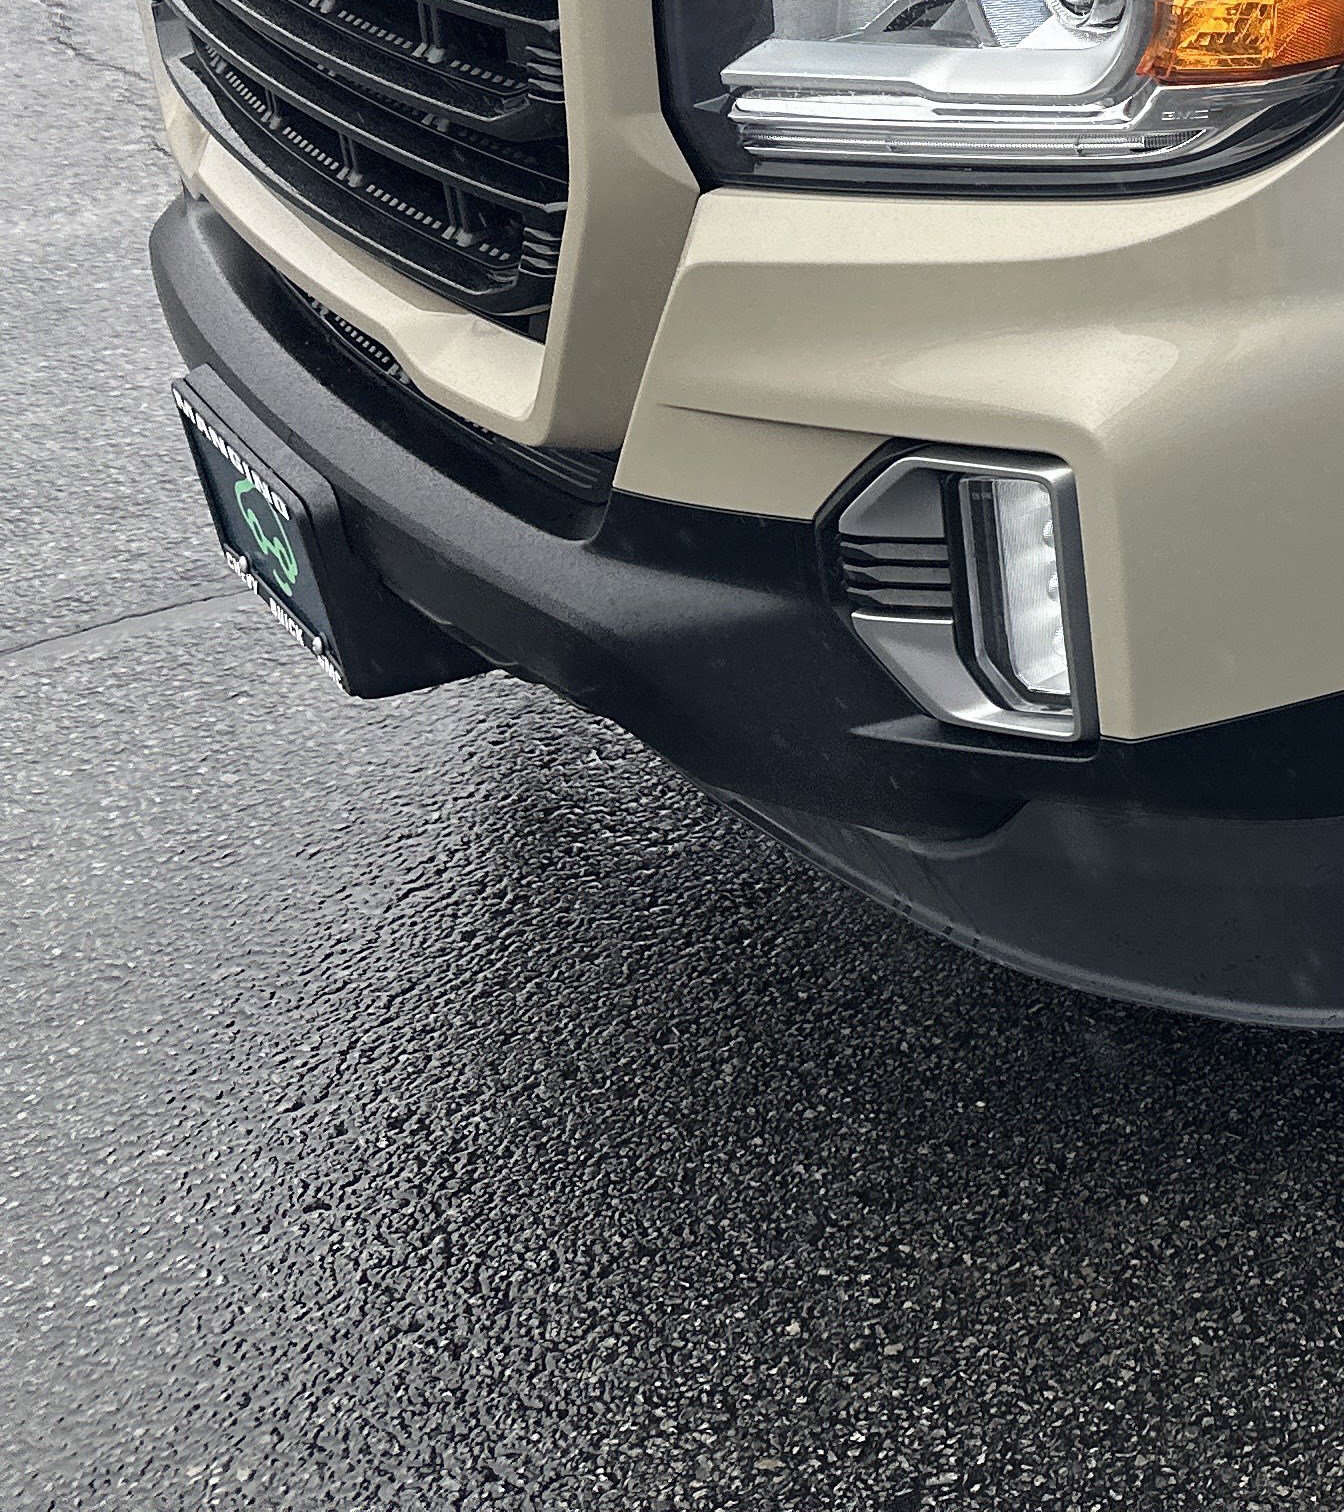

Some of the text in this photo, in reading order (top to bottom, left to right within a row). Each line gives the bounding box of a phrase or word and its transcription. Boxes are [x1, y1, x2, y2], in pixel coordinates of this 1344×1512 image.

[1161, 108, 1209, 121] GMC
[172, 387, 290, 522] MANGINO
[269, 597, 305, 647] BUICK
